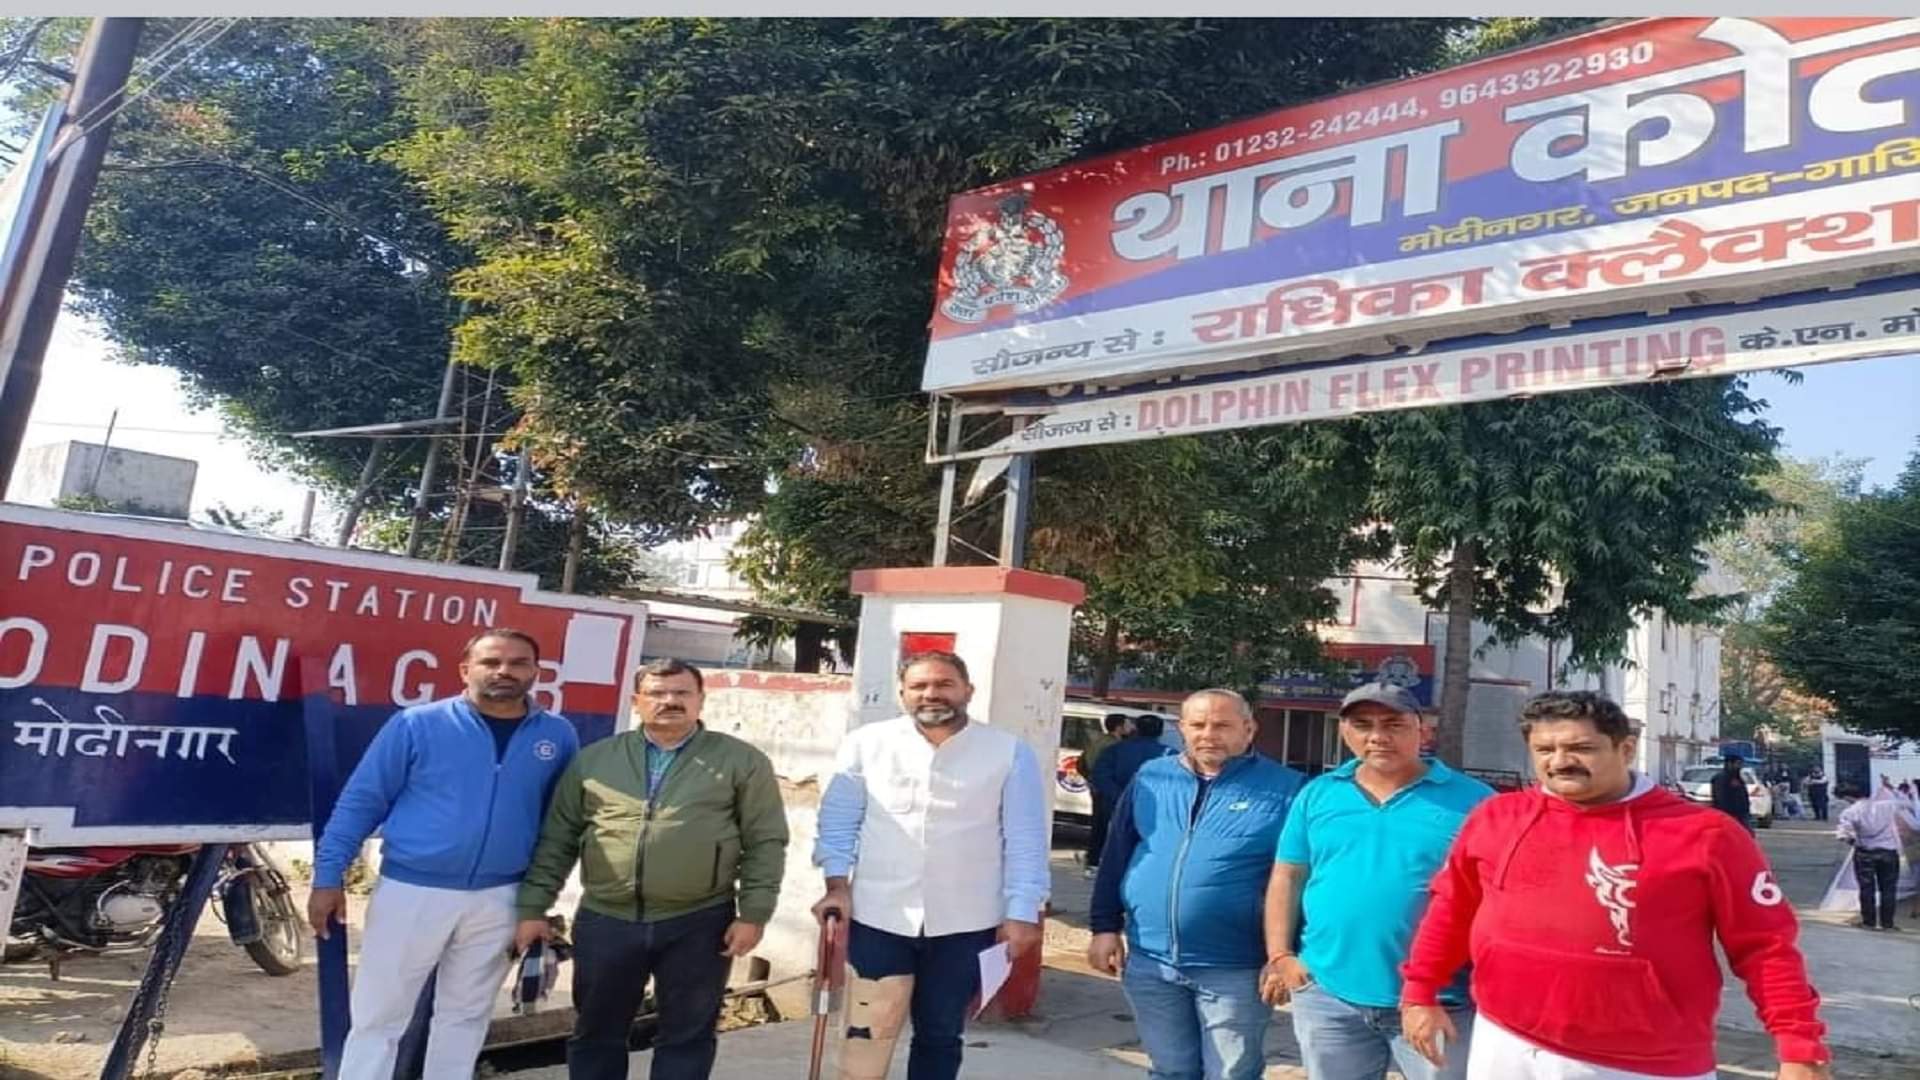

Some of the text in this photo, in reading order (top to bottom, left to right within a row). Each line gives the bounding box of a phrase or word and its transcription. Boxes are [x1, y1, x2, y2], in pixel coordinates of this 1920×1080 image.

[1161, 41, 1654, 175] Ph.: 01232-242444, 9643322930
[1110, 119, 1460, 262] थाना
[1398, 203, 1596, 252] मोदीनगर,
[1191, 266, 1494, 343] राधिका
[1137, 378, 1311, 433] DOLPHIN
[1330, 361, 1441, 409] FLEX
[1460, 326, 1726, 394] PRINTING
[18, 544, 497, 628] POLICE STATION
[1751, 870, 1783, 906] 6
